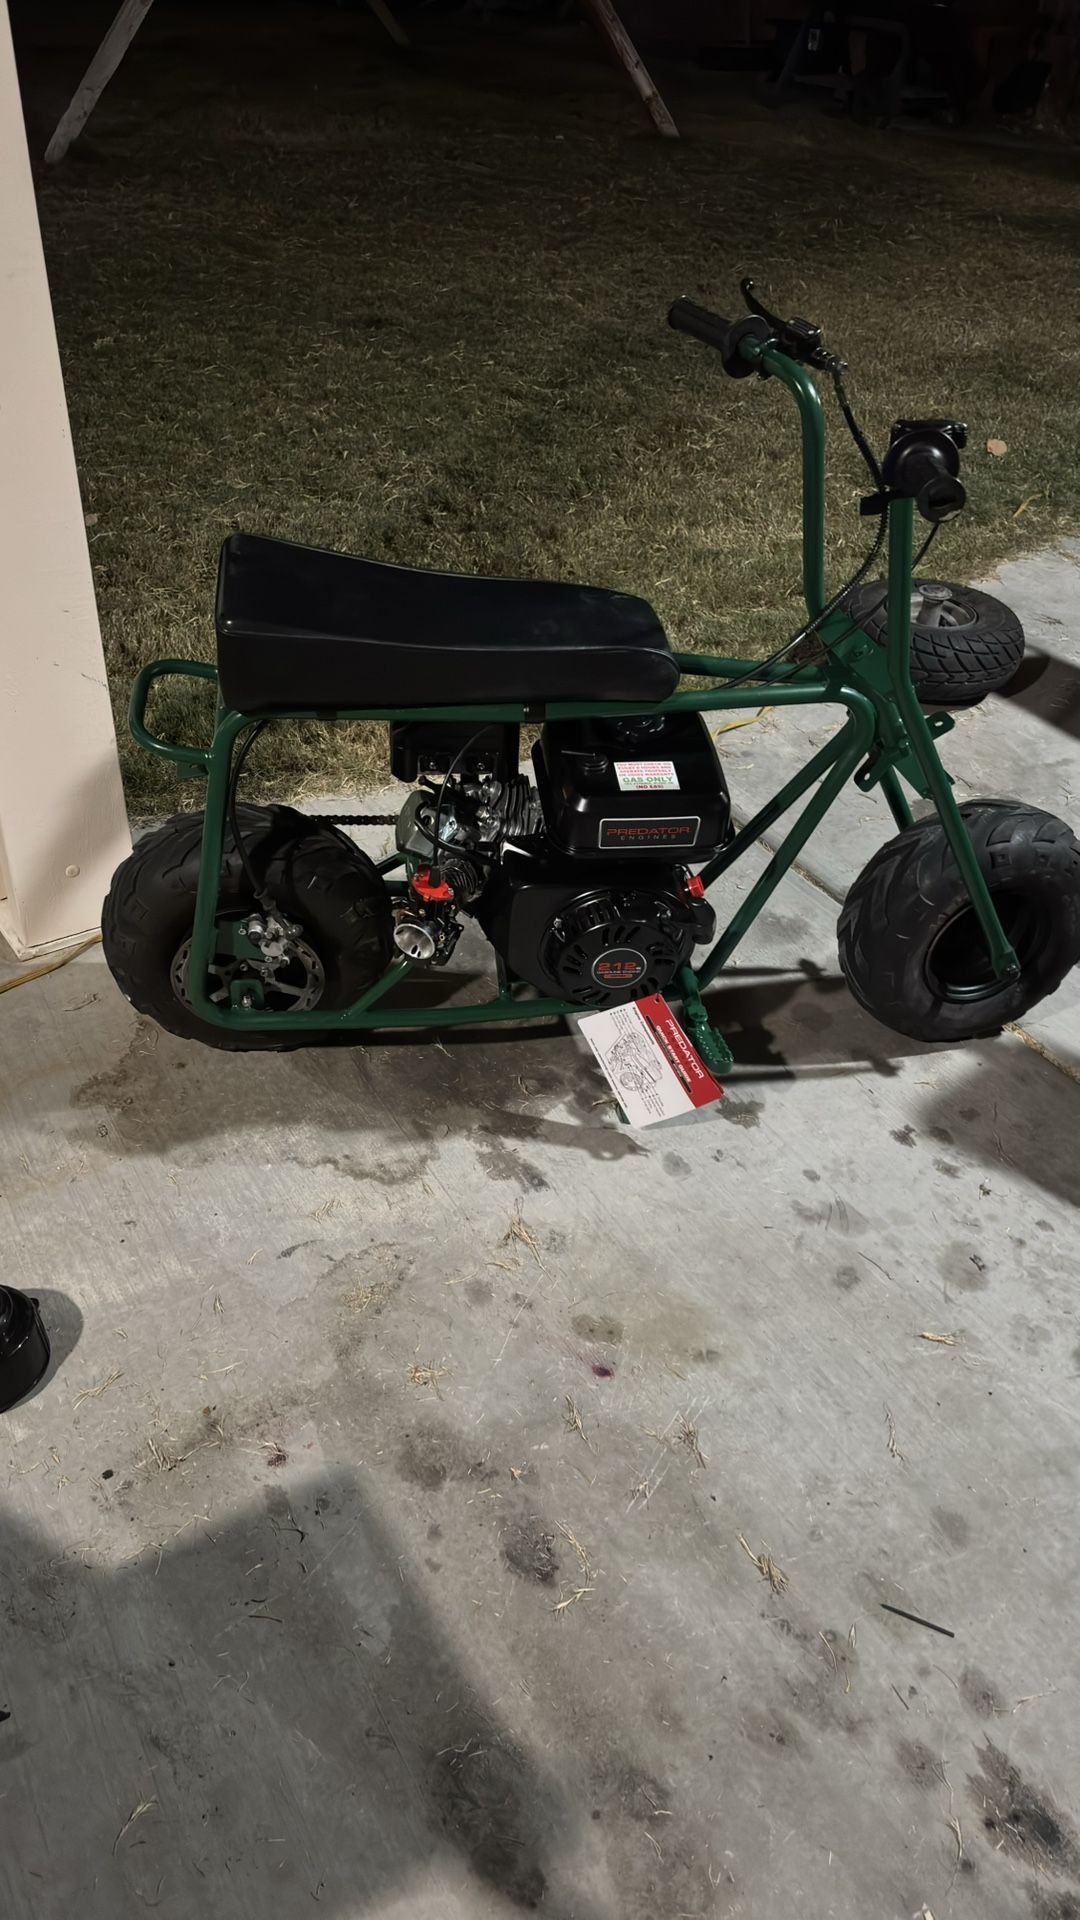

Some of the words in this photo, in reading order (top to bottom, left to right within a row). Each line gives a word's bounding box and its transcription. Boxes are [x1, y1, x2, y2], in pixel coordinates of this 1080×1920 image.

[607, 826, 690, 836] PREDATOR
[597, 962, 637, 972] 212
[656, 1025, 669, 1045] QUICK
[667, 1044, 681, 1064] START
[679, 1063, 692, 1083] GUIDE
[665, 1019, 705, 1080] PREDATOR
